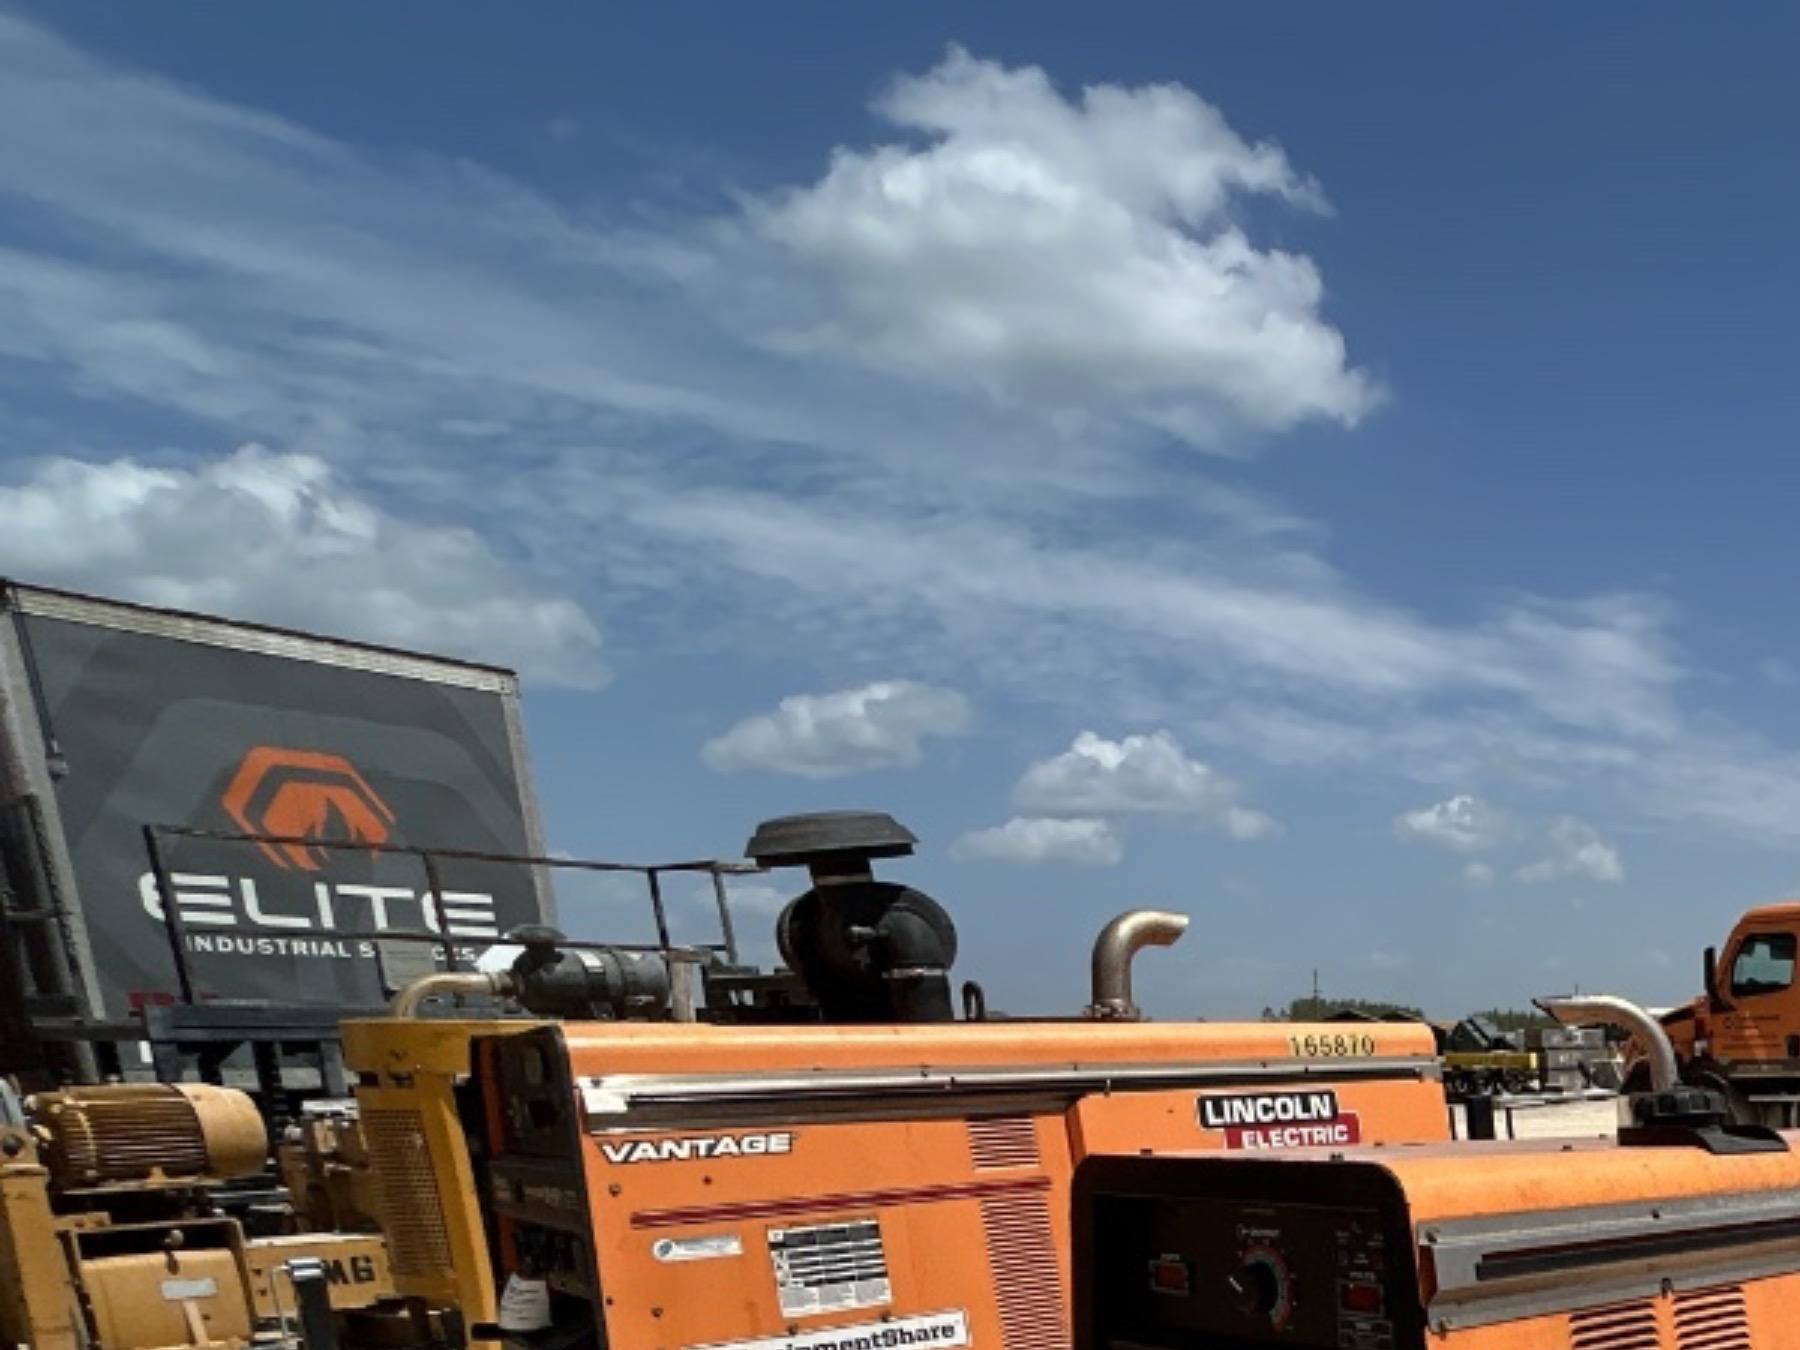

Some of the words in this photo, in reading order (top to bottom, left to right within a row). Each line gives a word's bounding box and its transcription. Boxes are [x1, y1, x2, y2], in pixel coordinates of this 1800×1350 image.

[138, 871, 499, 938] ELITE
[186, 935, 352, 958] INDUSTRIAL
[1204, 1094, 1332, 1126] LINCOLN
[601, 1131, 792, 1164] VANTAGE
[1241, 1123, 1349, 1150] ELECTRIC
